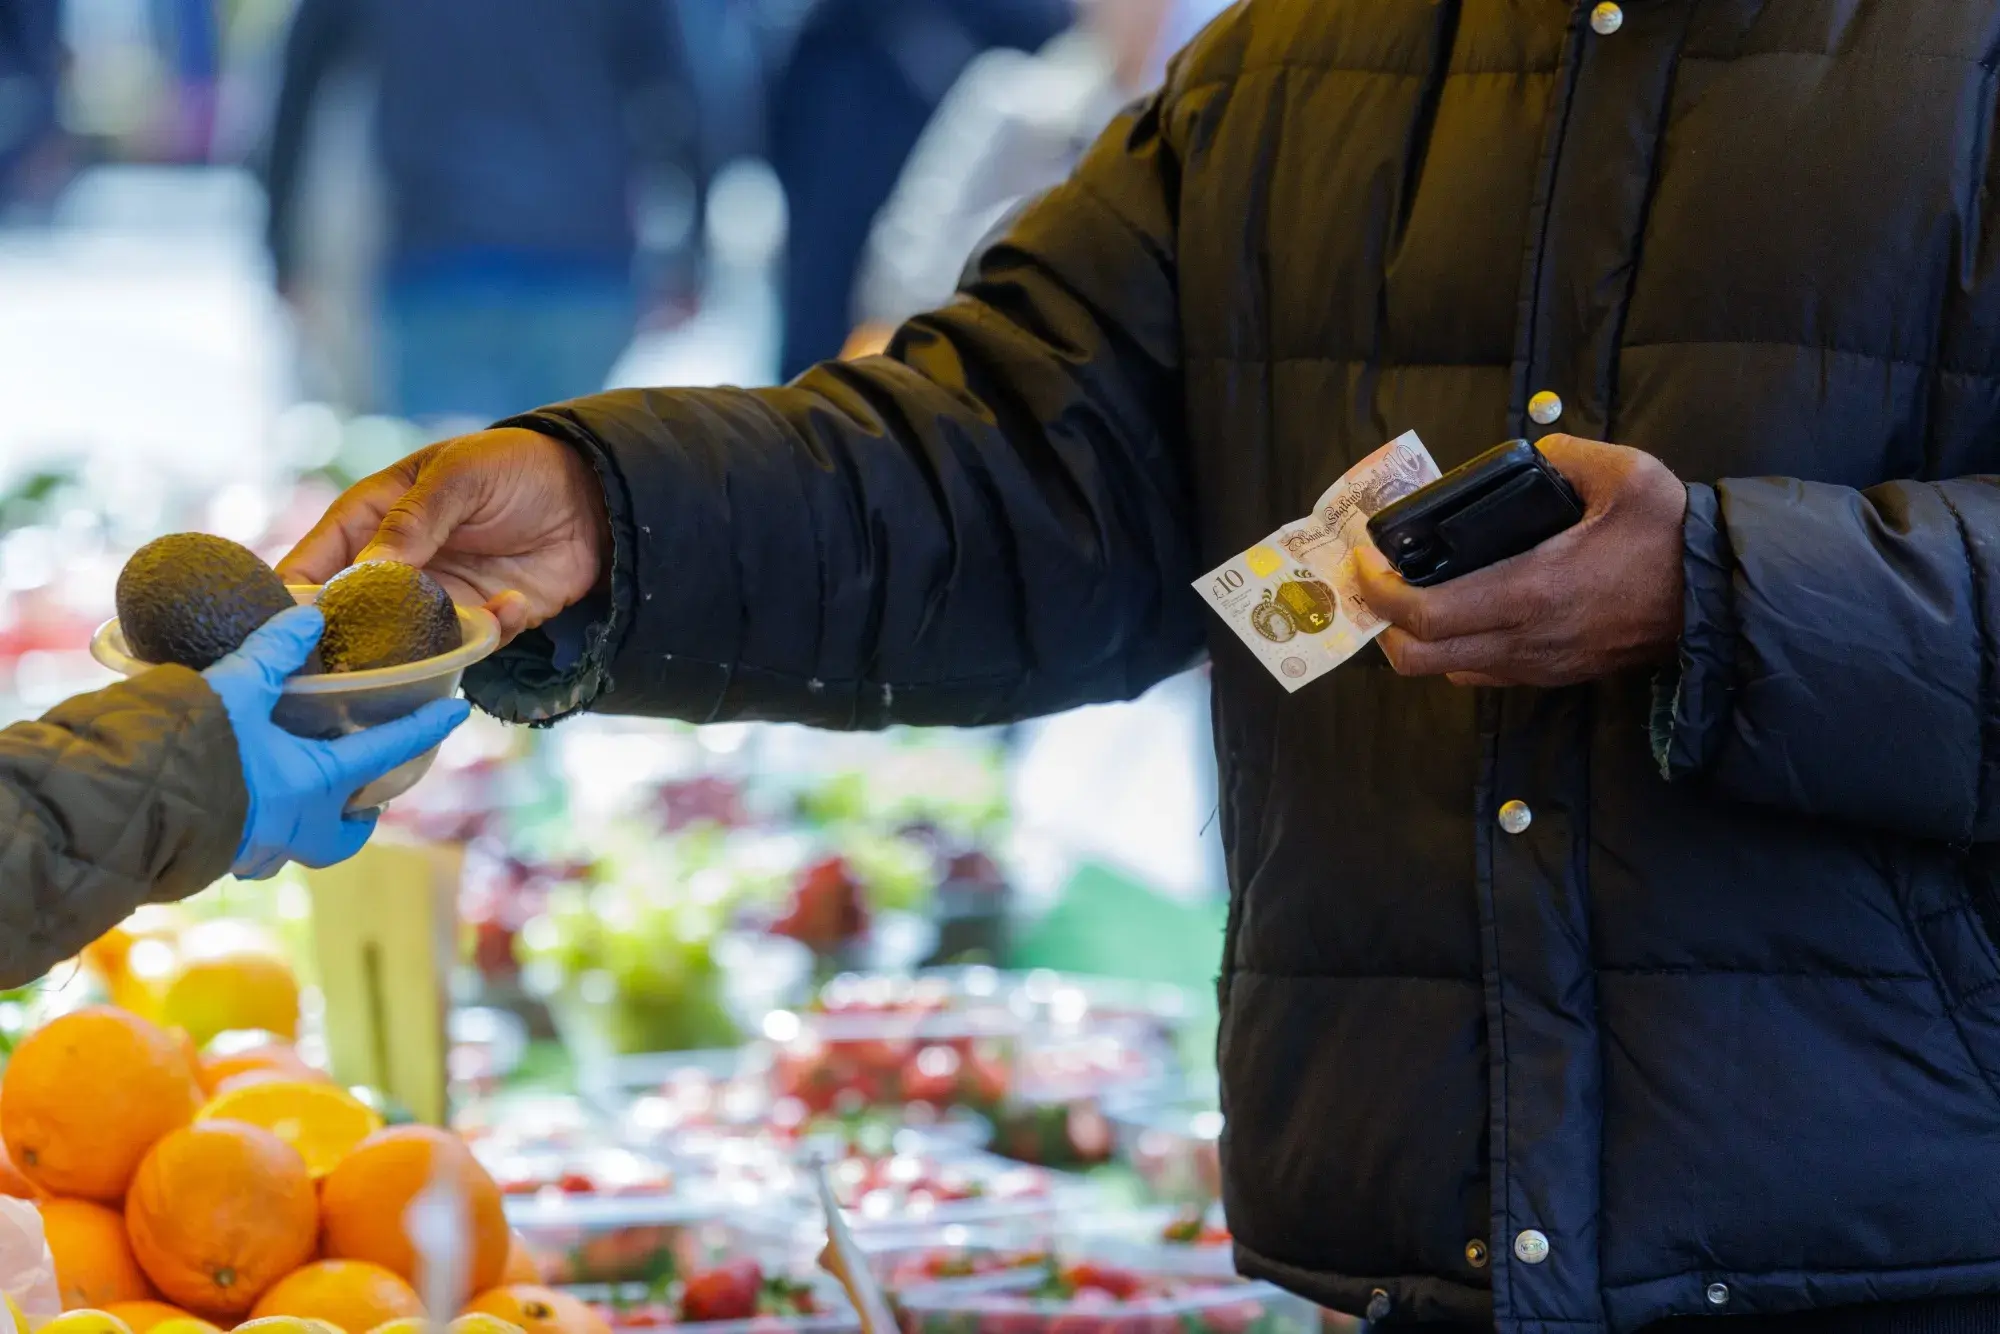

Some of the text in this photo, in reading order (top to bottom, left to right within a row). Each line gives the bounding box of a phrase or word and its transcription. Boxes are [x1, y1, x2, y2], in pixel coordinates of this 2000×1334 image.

[1281, 526, 1325, 552] Bank
[1324, 483, 1364, 527] England
[1212, 569, 1245, 600] £10
